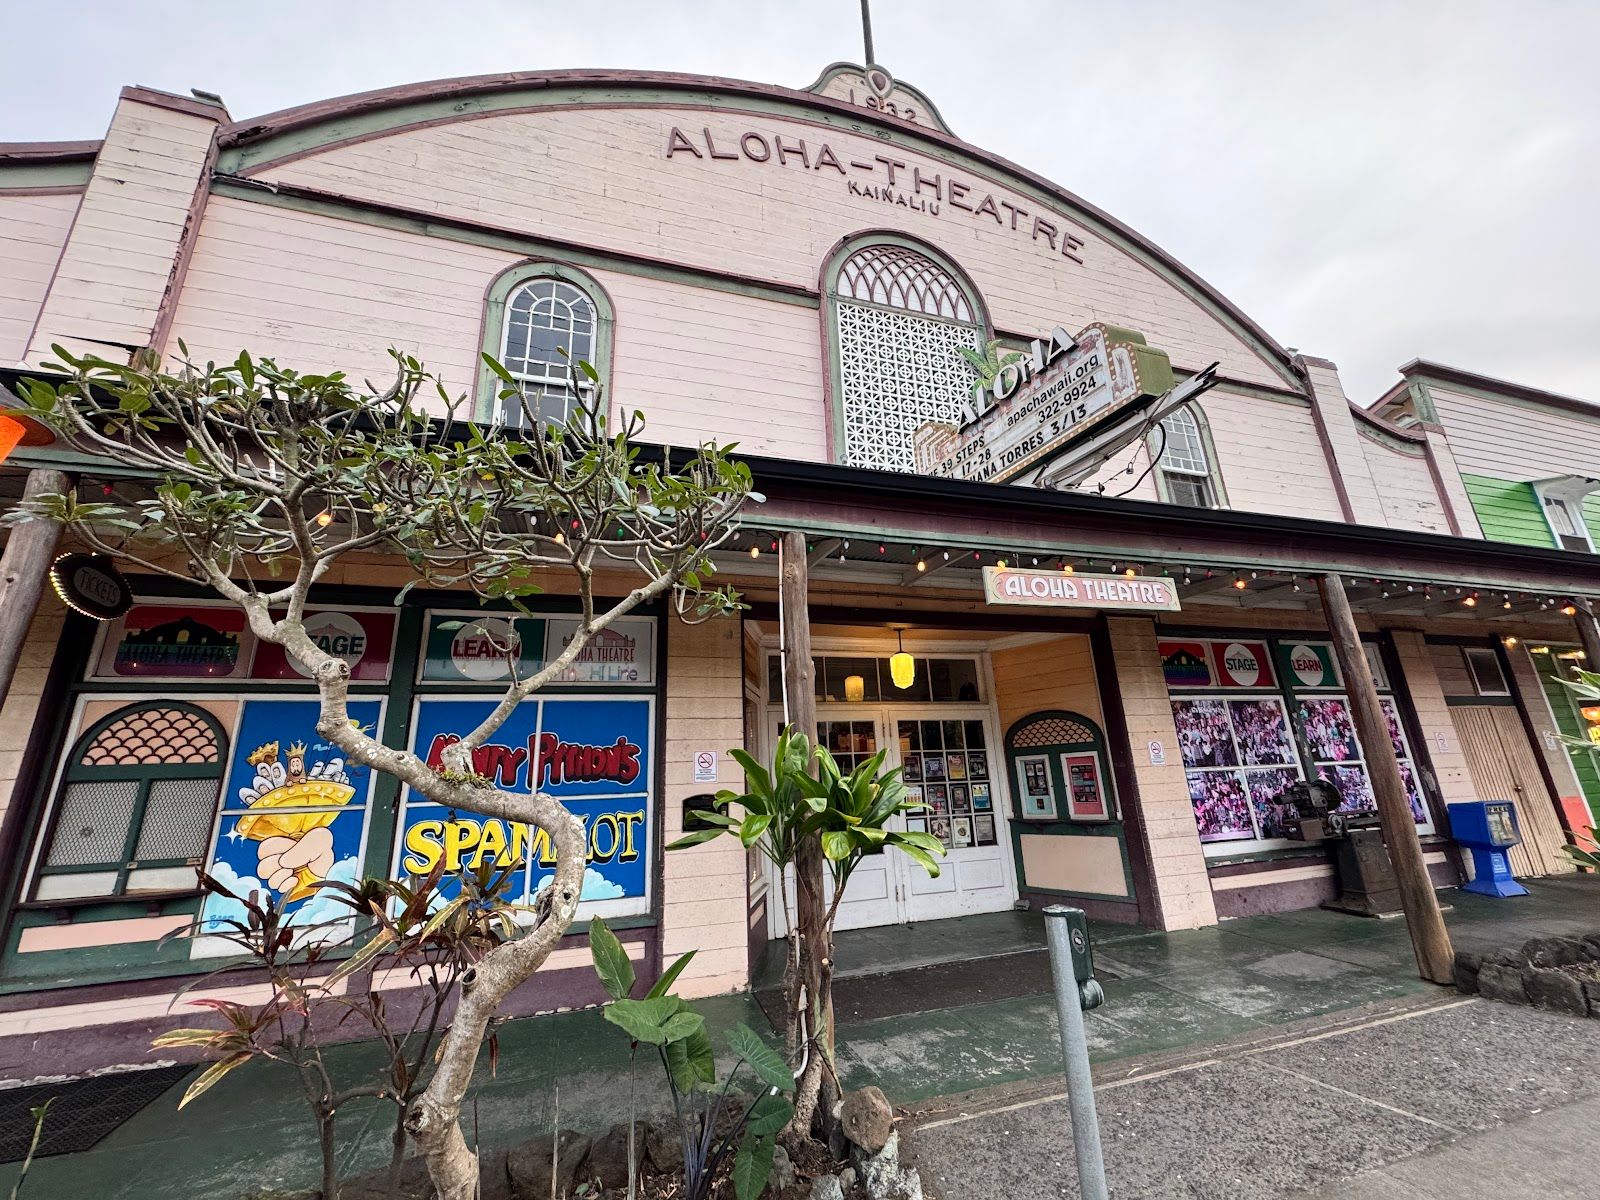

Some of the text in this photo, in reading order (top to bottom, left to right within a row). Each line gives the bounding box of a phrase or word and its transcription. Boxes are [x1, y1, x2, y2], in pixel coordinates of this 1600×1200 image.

[849, 87, 917, 122] 1932
[847, 179, 940, 216] KAINALIU
[957, 325, 1079, 434] ALOHA
[1006, 353, 1100, 427] apachawaii.org
[1037, 375, 1098, 425] 322-9924
[999, 431, 1044, 468] TORRES
[1051, 403, 1087, 435] 3/13
[941, 458, 953, 474] 39
[955, 435, 985, 463] STEPS
[961, 448, 992, 476] 17-28
[81, 568, 119, 604] TICKETS
[1005, 575, 1165, 604] ALOHA THEATRE
[453, 638, 521, 659] LEARN
[597, 647, 635, 662] THEATRE
[1225, 657, 1259, 671] STAGE
[1291, 659, 1323, 672] LEARN
[426, 733, 528, 788] MNTY
